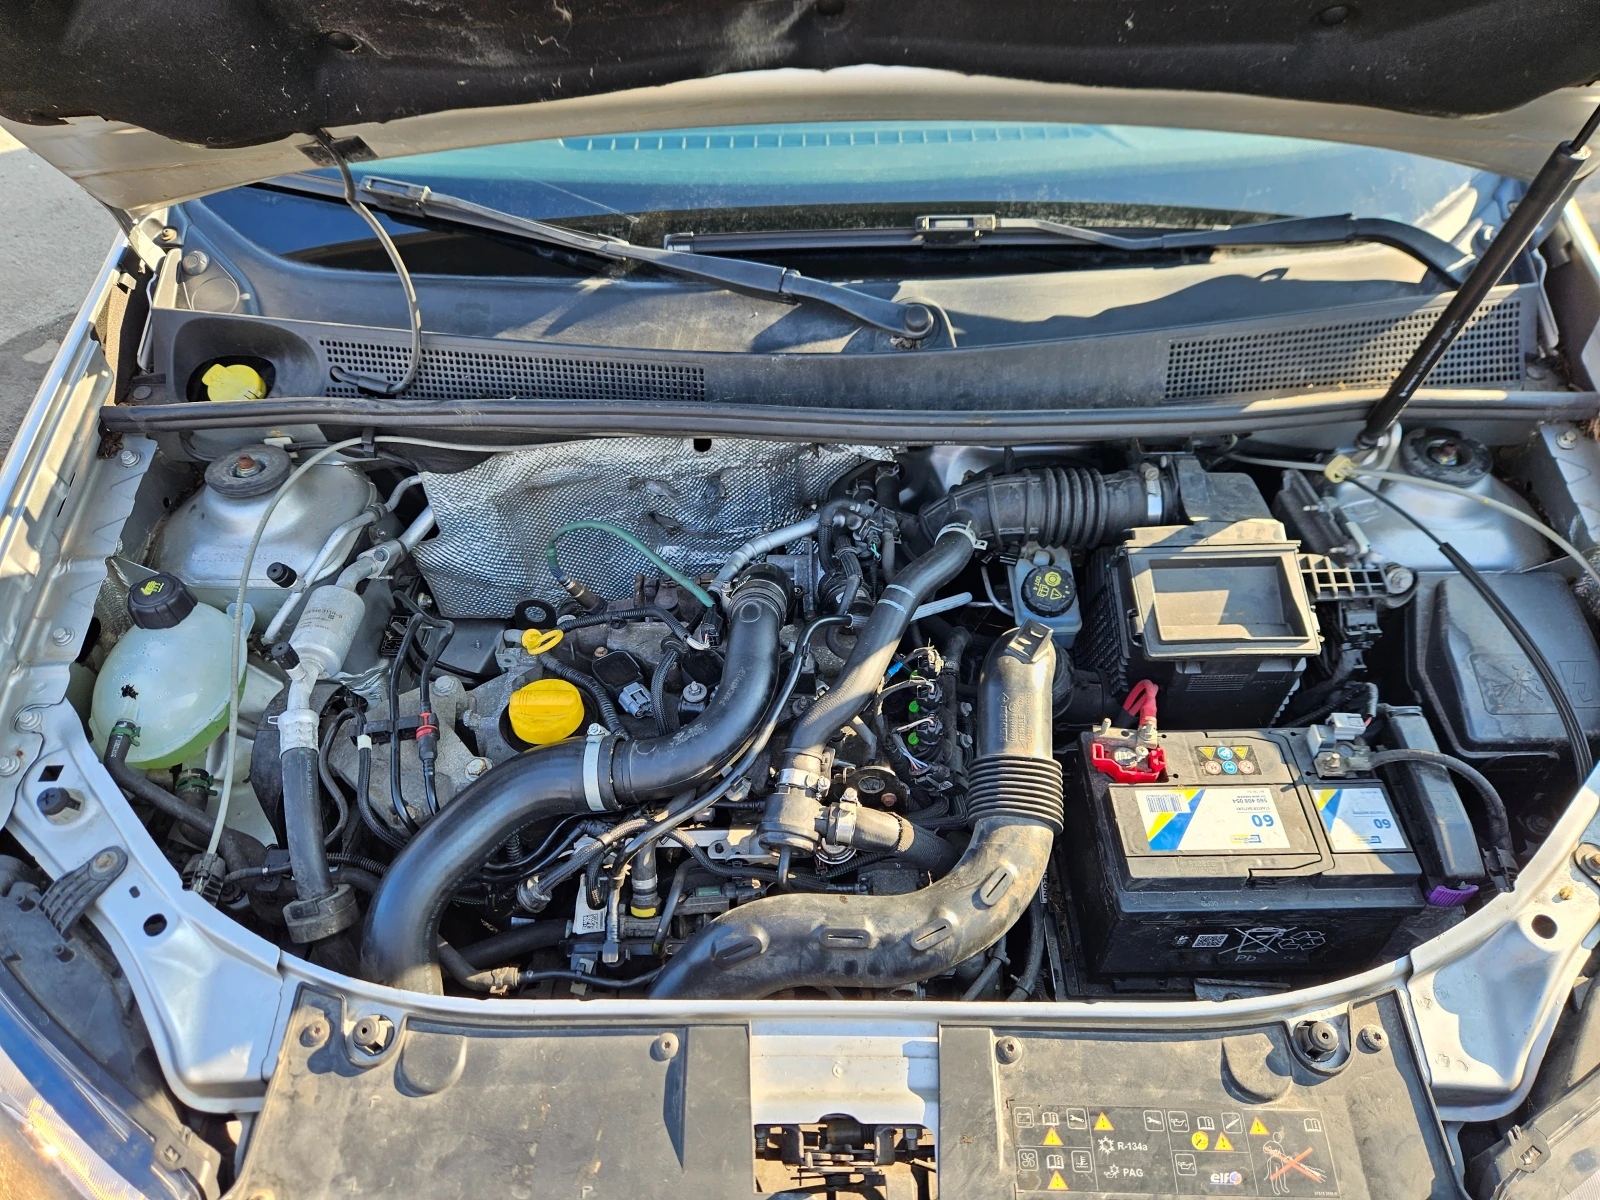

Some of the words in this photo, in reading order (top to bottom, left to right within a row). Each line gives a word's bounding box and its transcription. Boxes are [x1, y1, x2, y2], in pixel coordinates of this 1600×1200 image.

[1251, 814, 1274, 828] 60
[1373, 818, 1392, 829] 60
[1117, 1141, 1148, 1151] R-134a
[1123, 1168, 1144, 1177] PAG
[1210, 1172, 1232, 1184] elf
